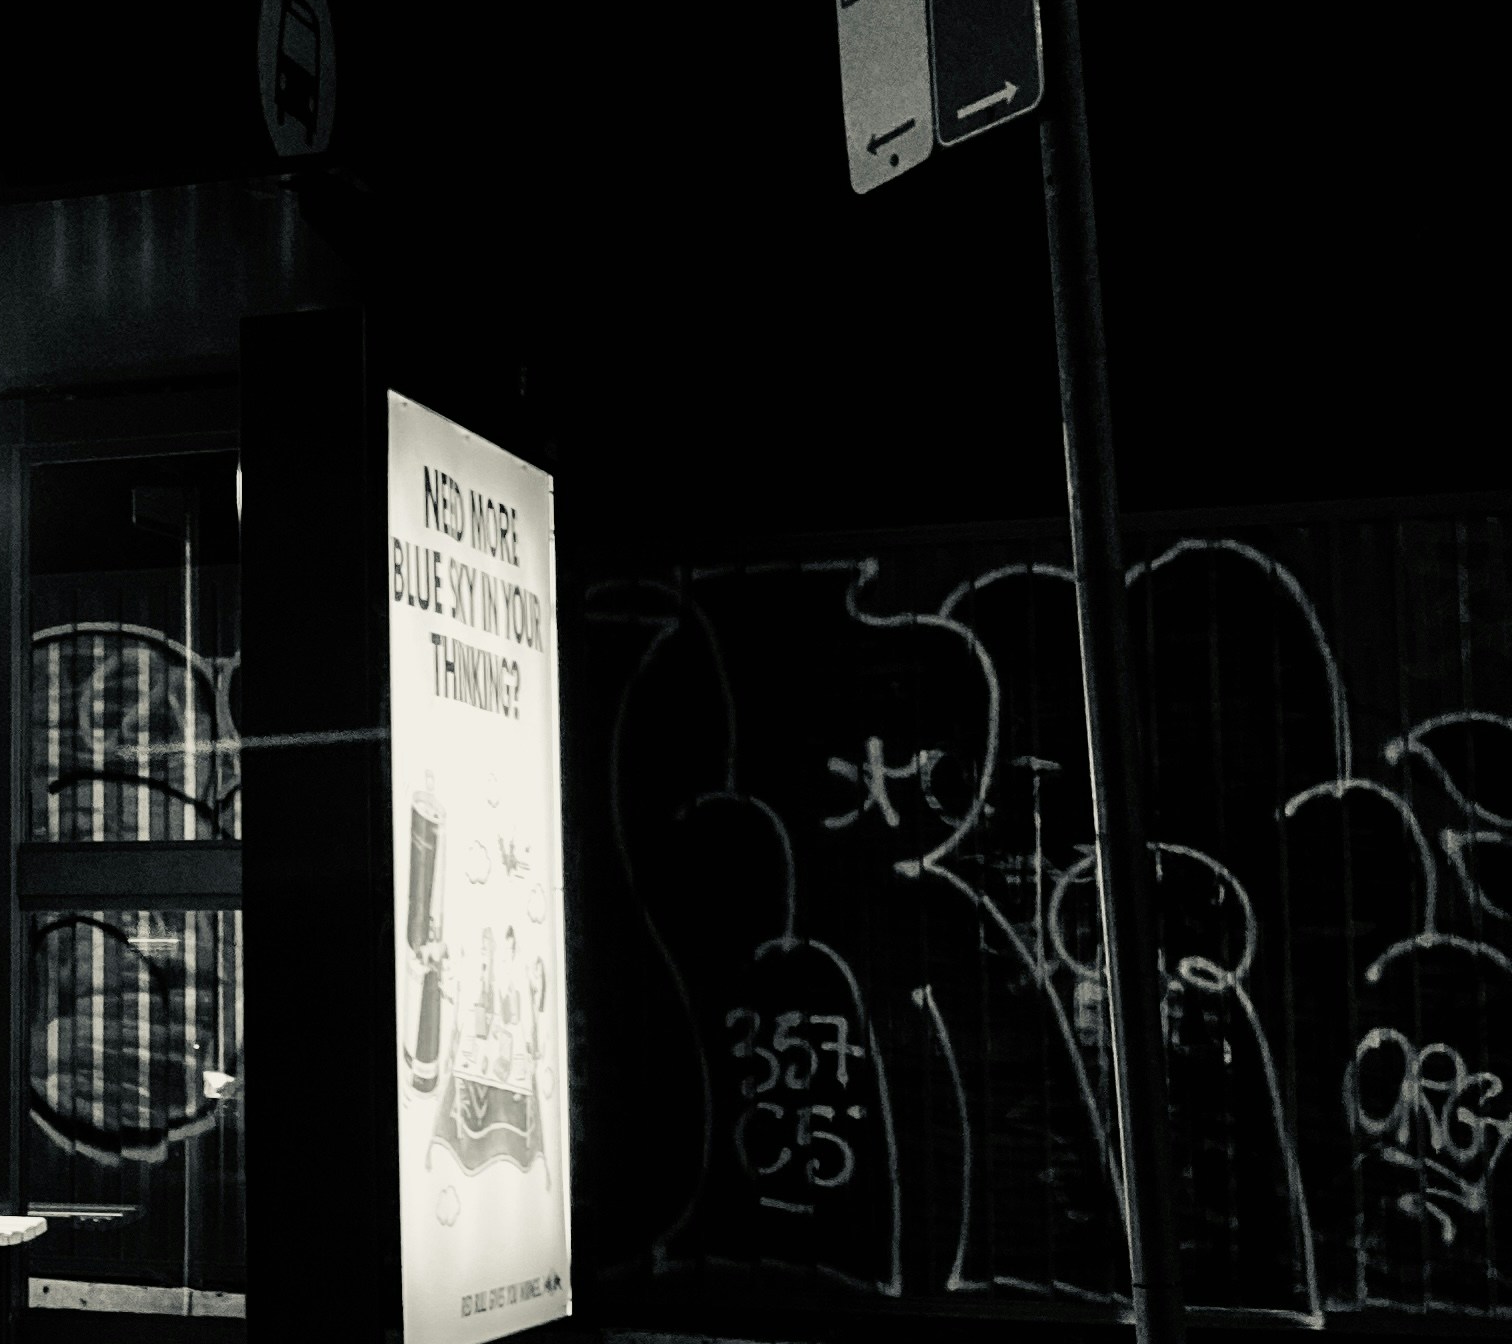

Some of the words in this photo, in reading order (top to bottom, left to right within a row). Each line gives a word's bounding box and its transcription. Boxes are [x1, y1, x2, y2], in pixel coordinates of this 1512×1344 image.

[469, 488, 520, 568] MORE
[392, 536, 443, 615] BLUE
[449, 557, 476, 629] SKY
[480, 570, 501, 637] IN
[501, 580, 545, 654] YOUR
[429, 630, 522, 721] THINKING?
